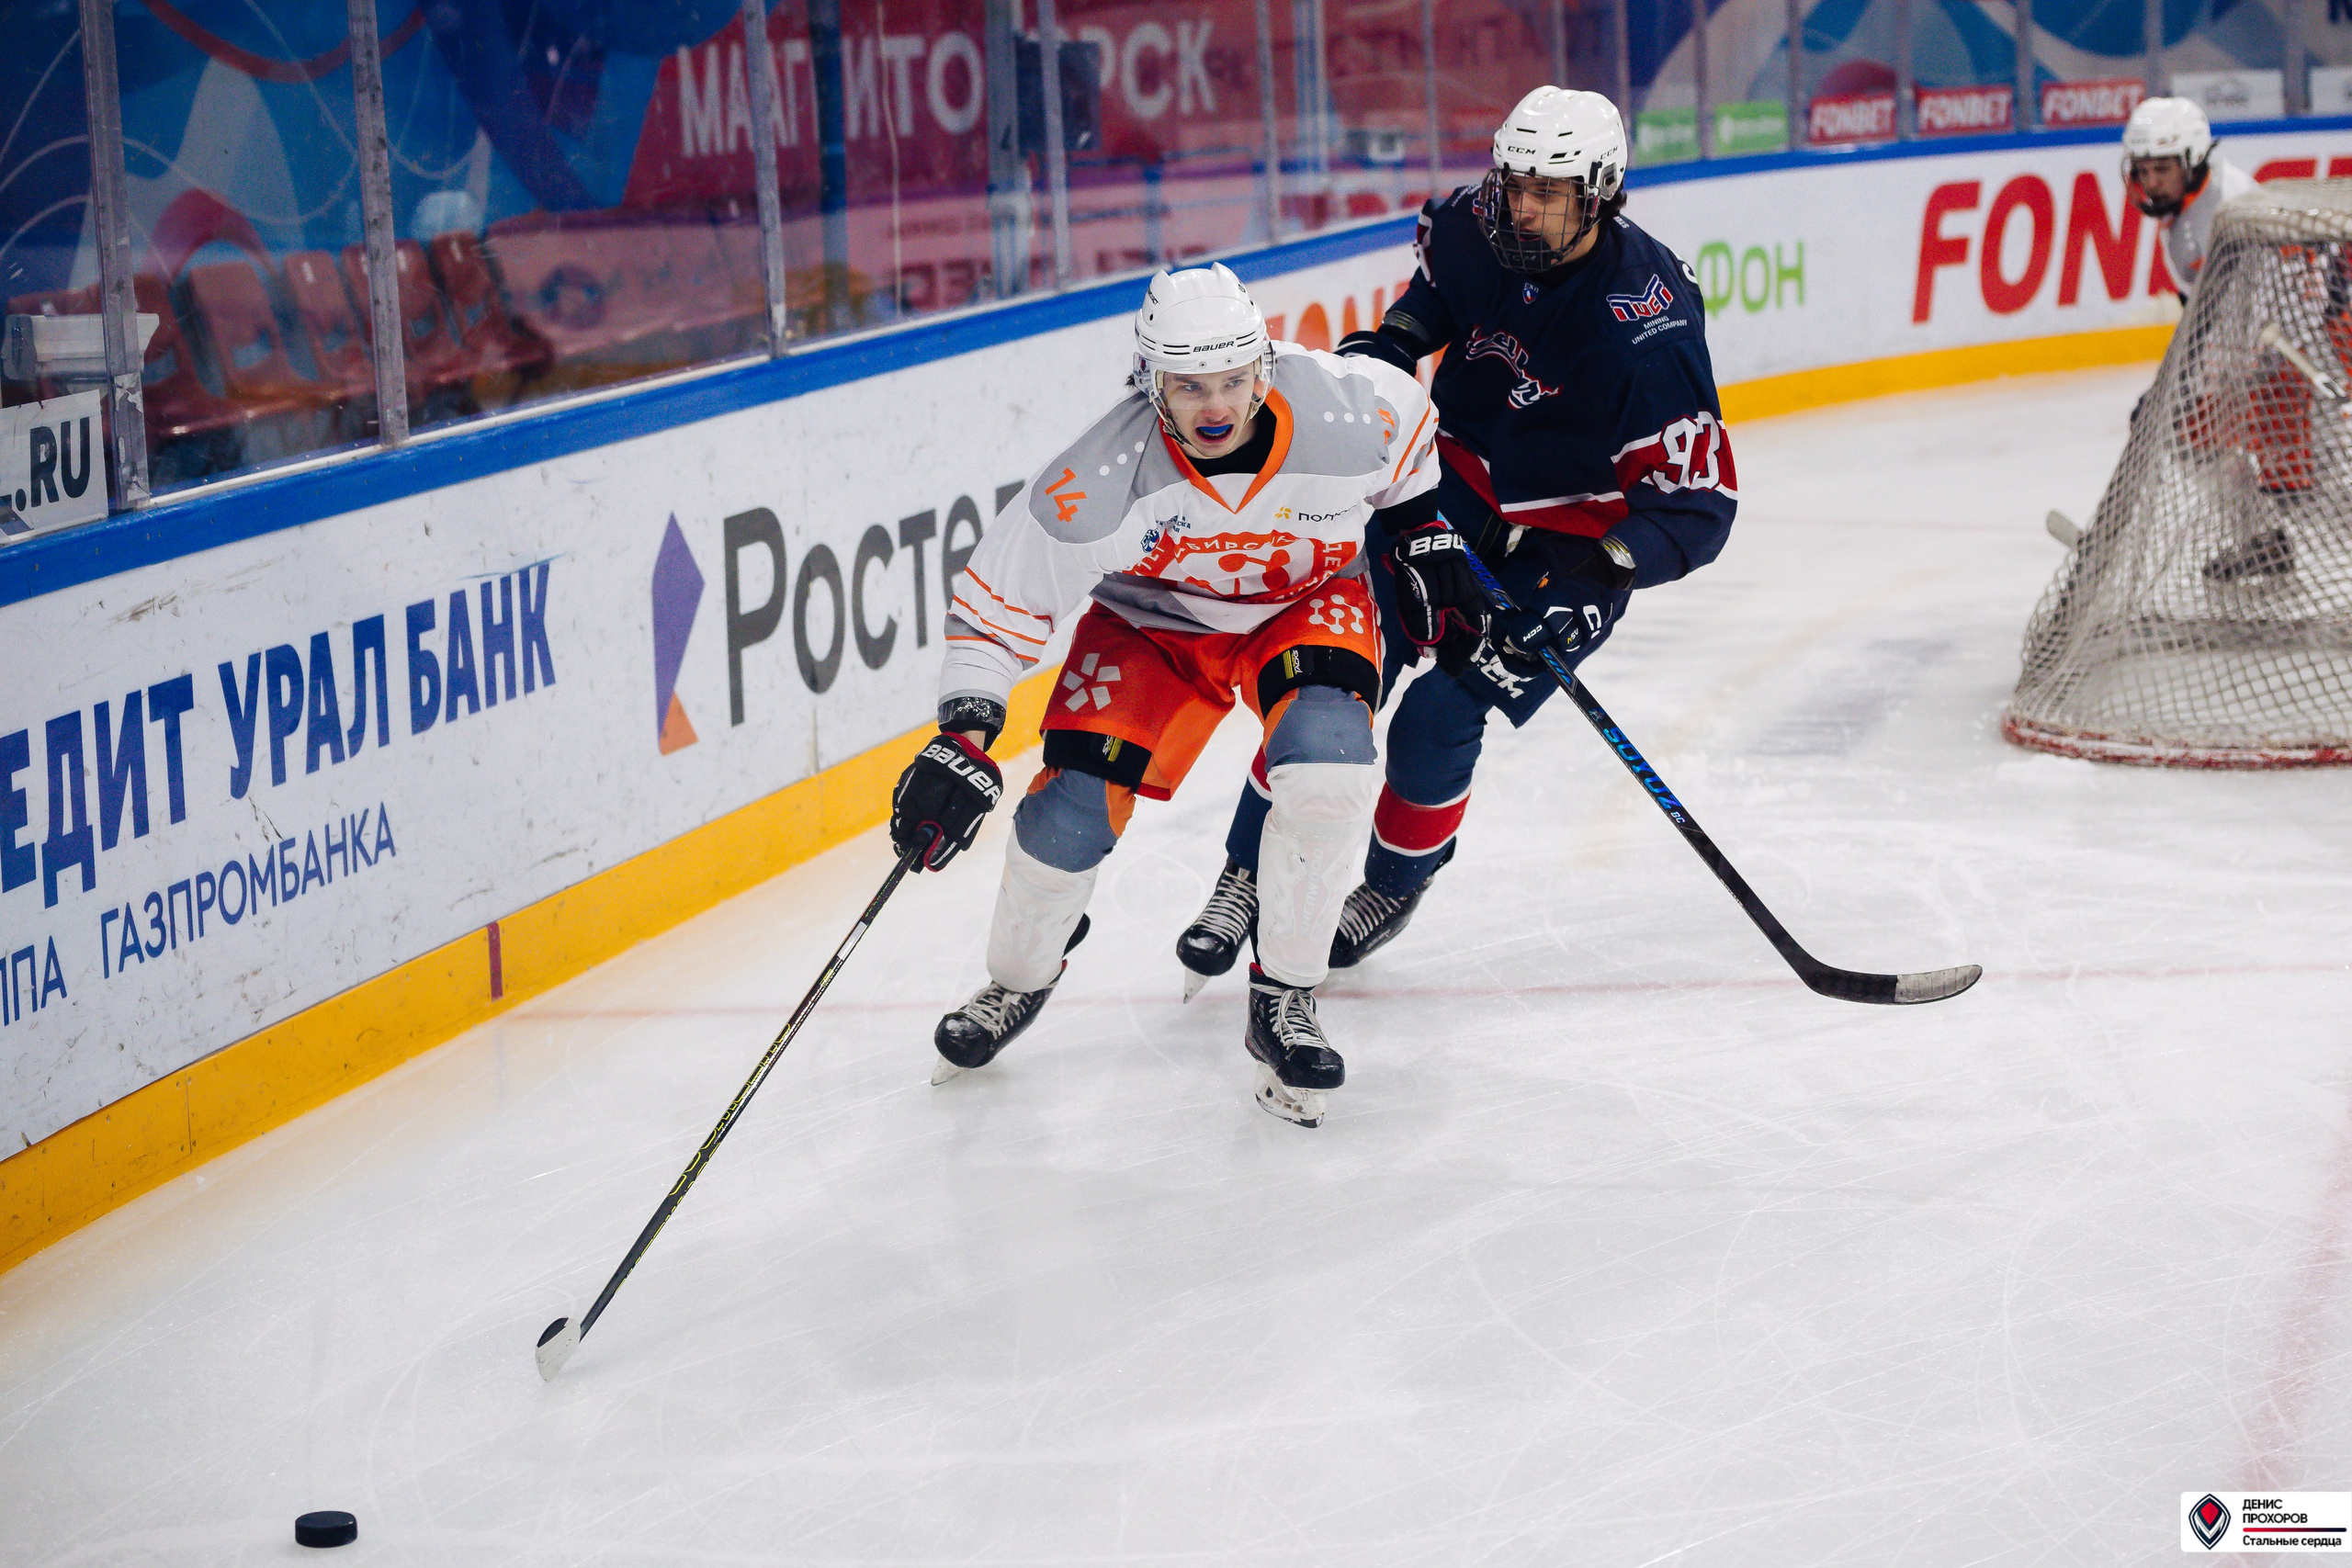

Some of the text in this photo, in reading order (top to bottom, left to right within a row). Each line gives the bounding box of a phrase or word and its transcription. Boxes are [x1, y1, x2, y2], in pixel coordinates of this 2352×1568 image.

[1507, 145, 1536, 155] CCM
[1600, 145, 1619, 161] CCM
[1193, 341, 1235, 353] BAUER
[1632, 319, 1688, 344] UNITED COMPANY
[1643, 315, 1669, 330] MINING
[0, 416, 90, 512] .RU
[1653, 410, 1721, 494] 93
[1045, 468, 1087, 523] 14
[723, 479, 1025, 728] Росте
[1522, 625, 1544, 643] CCM
[218, 615, 390, 800] УРАЛ
[405, 559, 557, 736] БАНК
[921, 743, 1001, 806] BAUER
[1603, 726, 1682, 810] SOYUZ
[100, 800, 397, 980] ГАЗПРОМБАНКА
